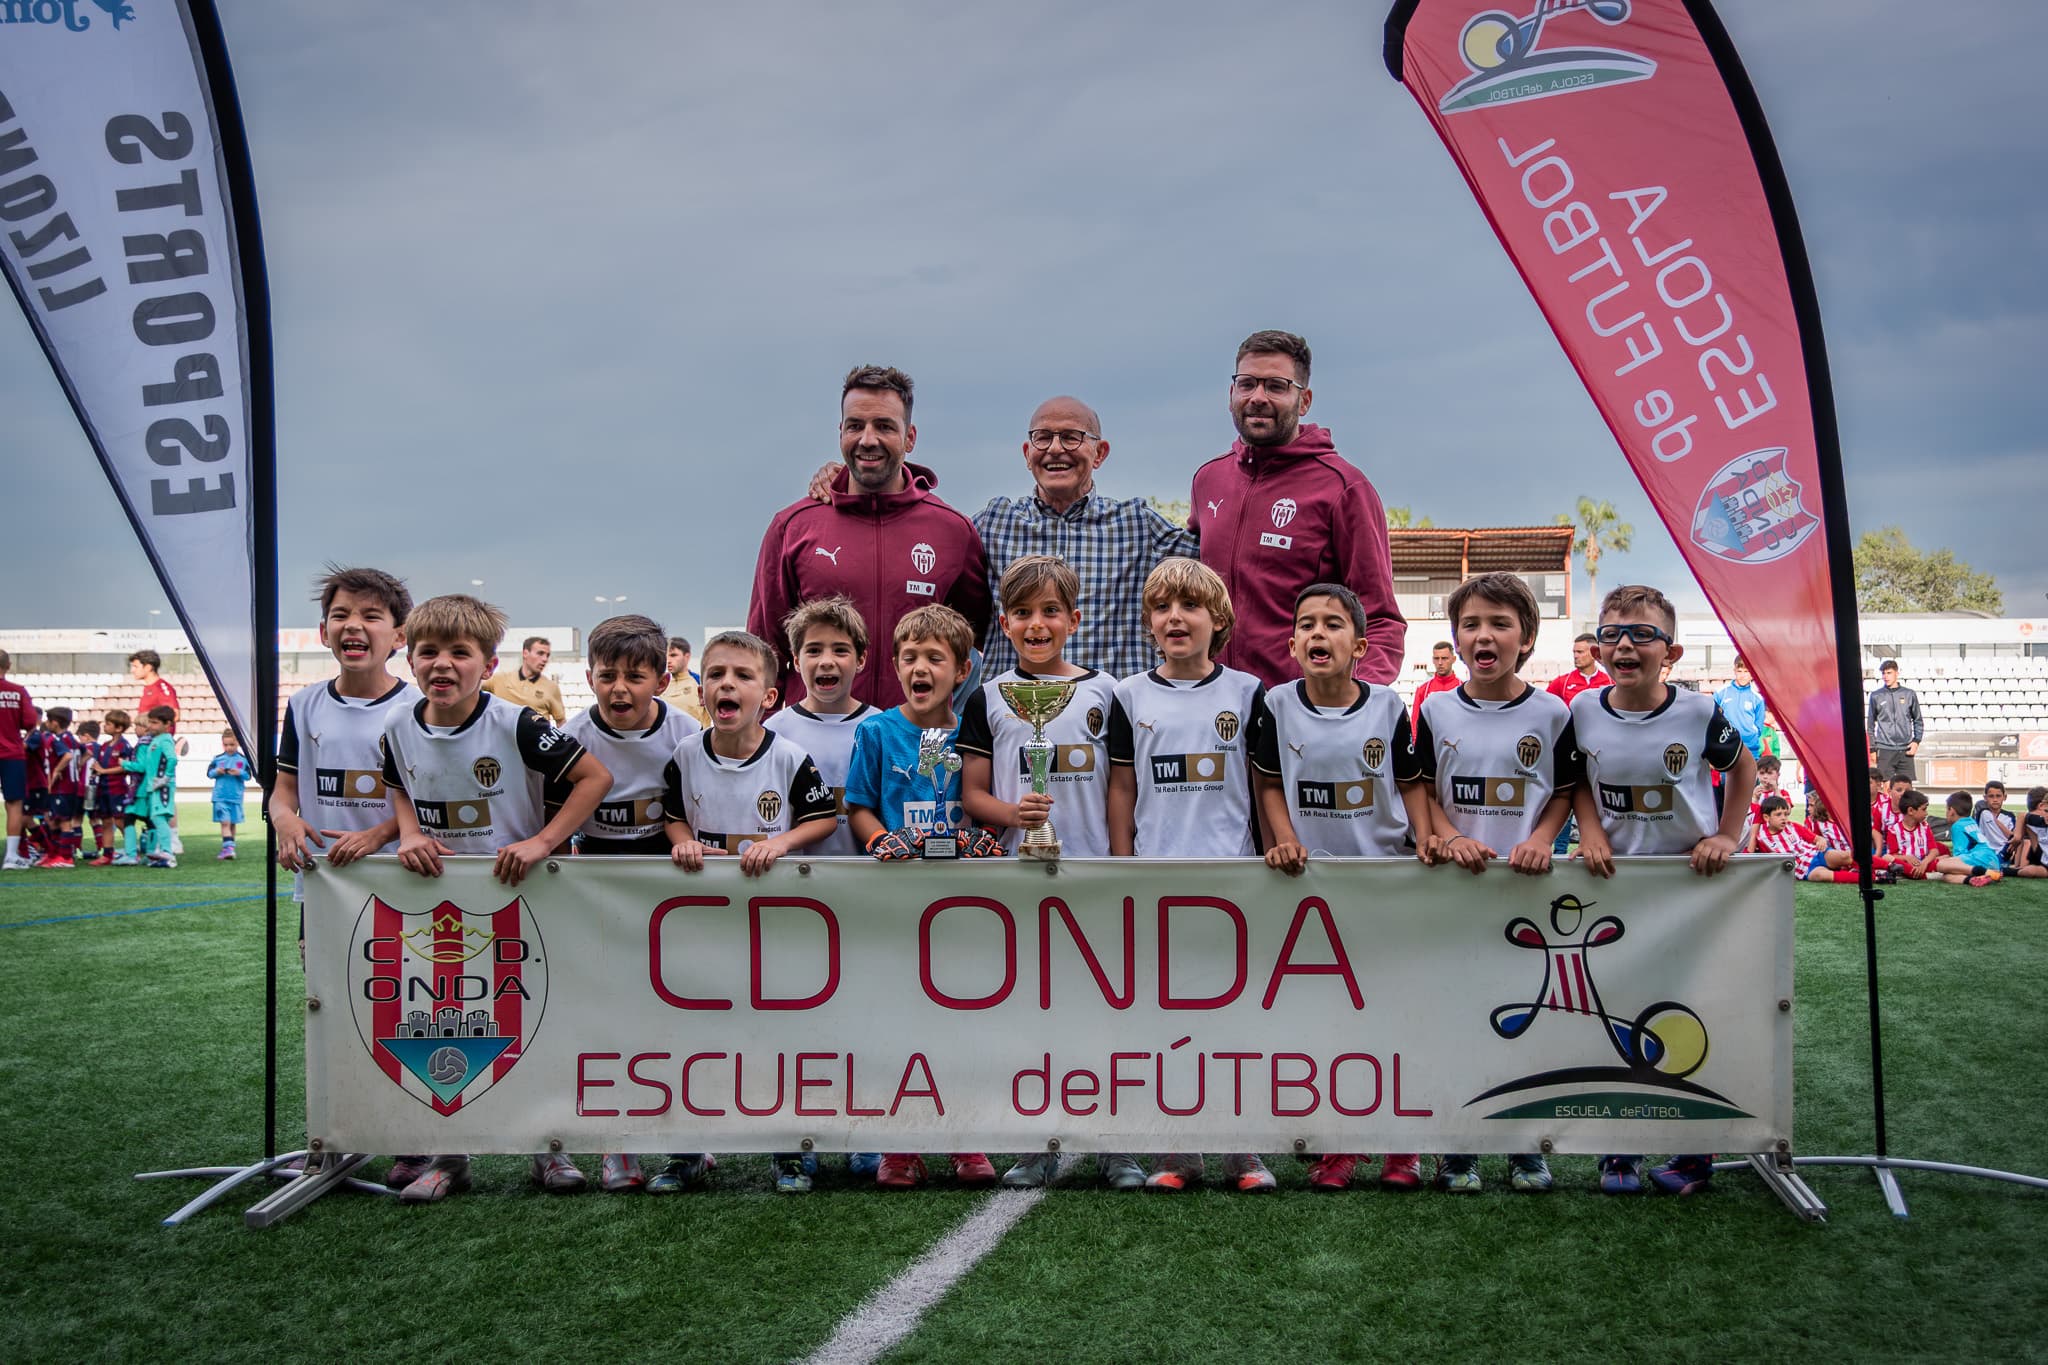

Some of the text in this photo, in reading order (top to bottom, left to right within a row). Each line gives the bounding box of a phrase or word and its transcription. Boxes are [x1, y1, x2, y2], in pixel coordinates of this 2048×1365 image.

[908, 583, 920, 592] TM
[1154, 761, 1180, 779] TM
[318, 775, 338, 792] TM
[1020, 774, 1094, 785] TM Estate Group
[1203, 784, 1224, 793] Group
[1302, 787, 1329, 804] TM
[1455, 783, 1480, 800] TM
[335, 800, 360, 808] Estate
[361, 801, 386, 810] Group
[1602, 789, 1626, 808] TM
[418, 806, 442, 824] TM
[599, 808, 628, 822] TM
[908, 808, 934, 824] TM
[1313, 810, 1329, 818] Real
[1329, 811, 1353, 820] Estate
[1353, 809, 1374, 818] Group
[1463, 807, 1478, 815] Real
[1479, 808, 1500, 817] Estate
[1500, 808, 1524, 818] Group
[1649, 814, 1674, 822] Group
[442, 830, 467, 839] Estate
[467, 828, 494, 838] Group
[649, 896, 1365, 1011] CD ONDA
[363, 975, 531, 1002] ONDA
[577, 1036, 1434, 1117] ESCUELA deFÚTBOL
[1555, 1104, 1685, 1118] ESCUELA deFÚTBOL
